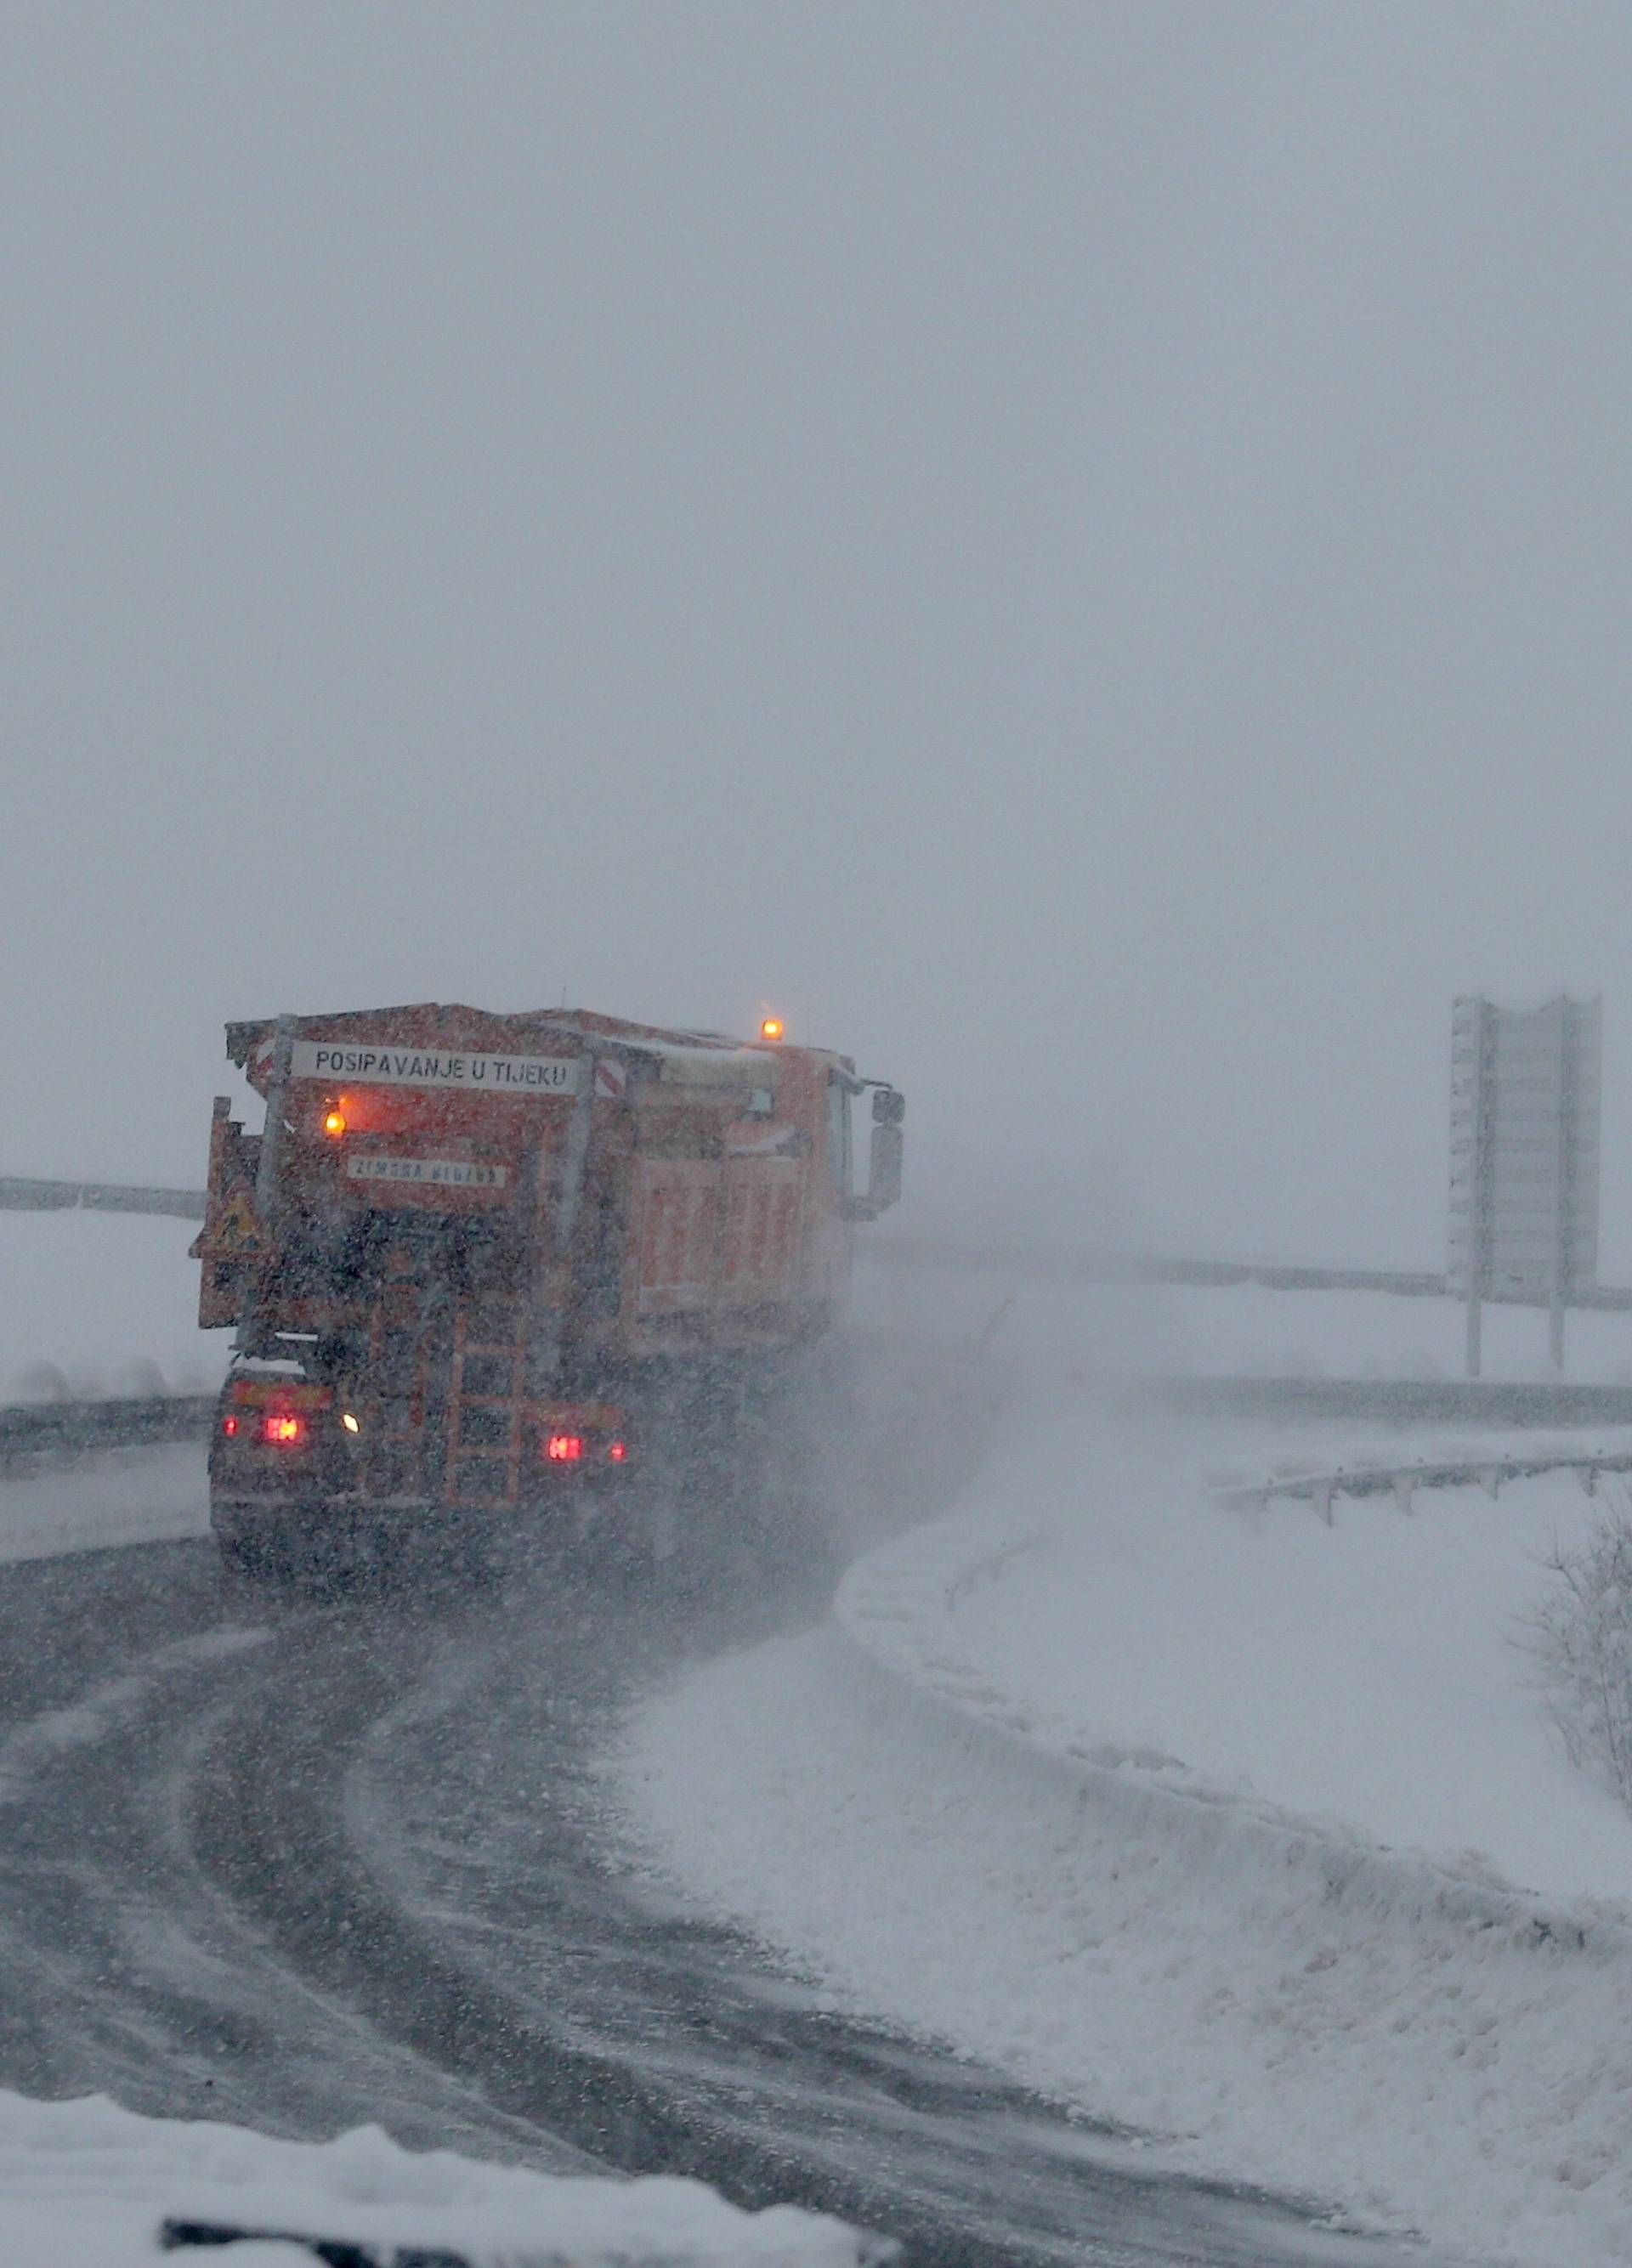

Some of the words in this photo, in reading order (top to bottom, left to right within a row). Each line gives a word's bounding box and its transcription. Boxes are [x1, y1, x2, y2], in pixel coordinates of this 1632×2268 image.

[315, 1050, 464, 1079] POSIPAVANJE
[473, 1060, 485, 1081] U
[493, 1061, 566, 1086] TIJEKU
